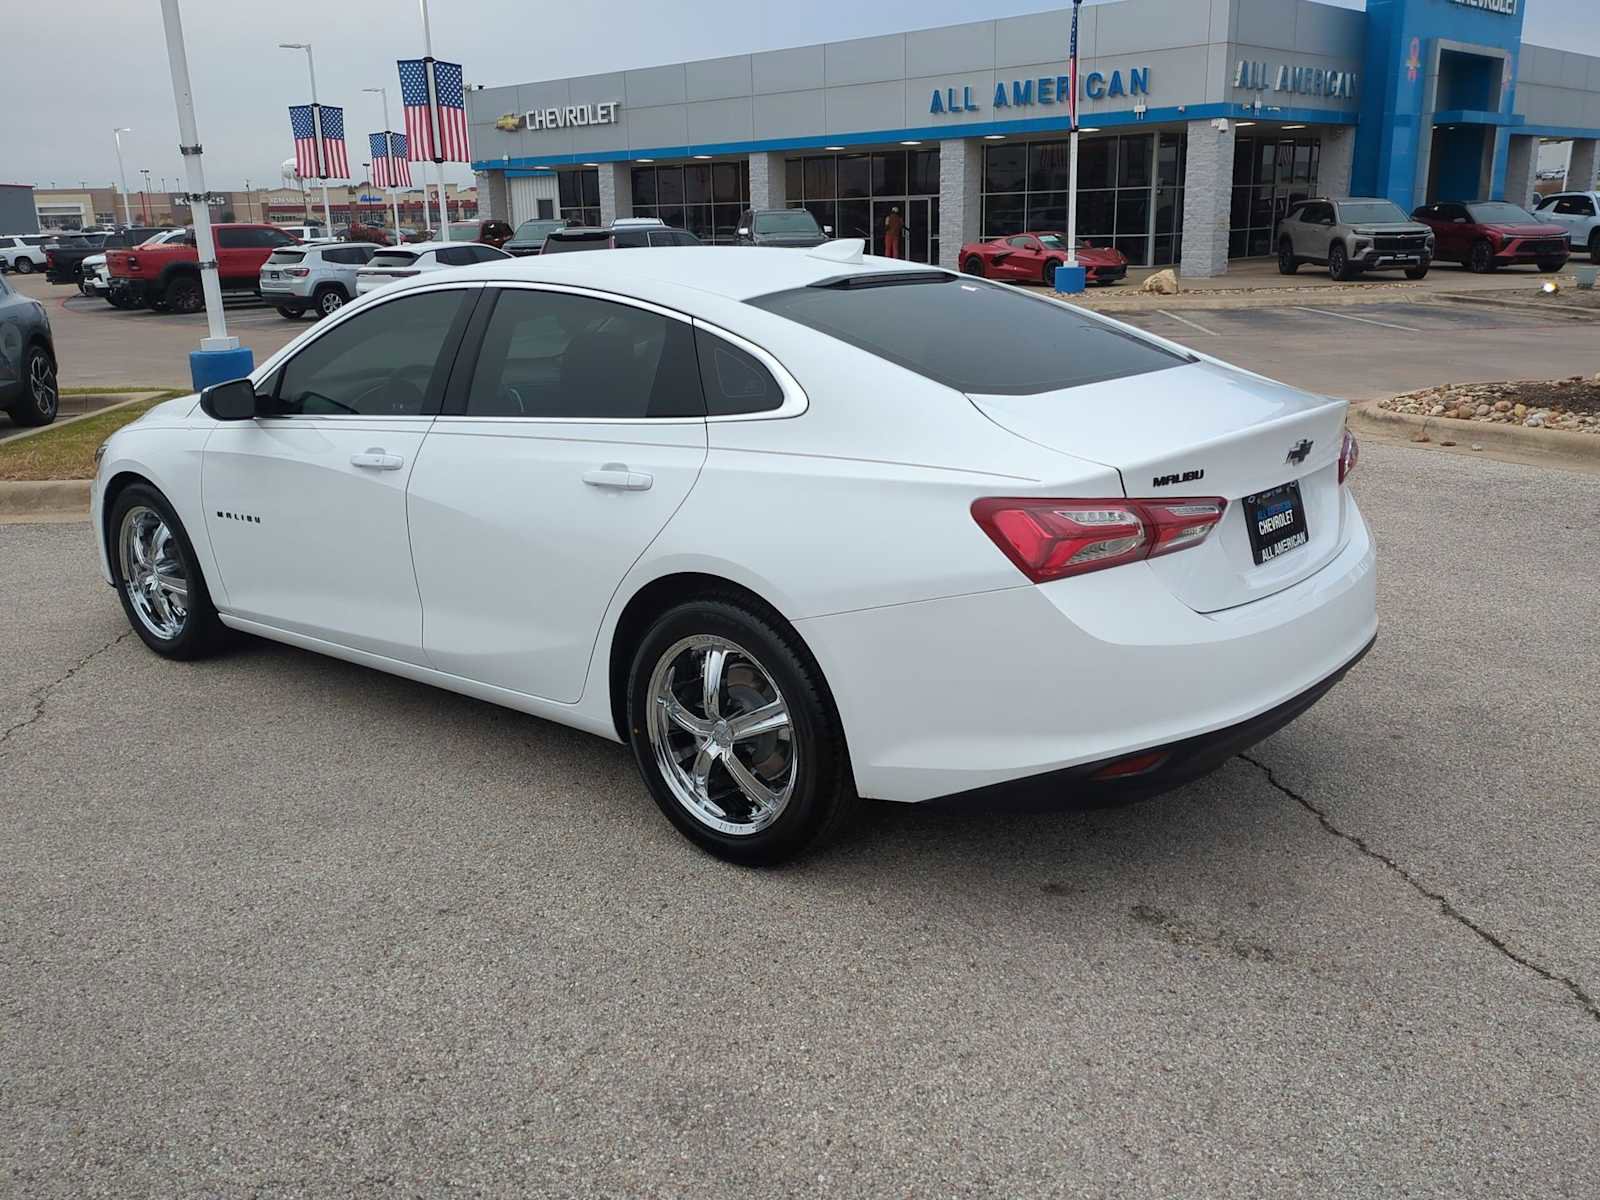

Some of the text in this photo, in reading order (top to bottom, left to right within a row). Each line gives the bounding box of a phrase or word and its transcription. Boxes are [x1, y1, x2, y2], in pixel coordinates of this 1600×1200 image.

[929, 67, 1150, 114] ALL AMERCAN
[1232, 60, 1360, 98] ALL AMERICAN
[525, 101, 619, 130] CHEVROLET
[174, 196, 225, 206] KL'S
[1152, 469, 1204, 488] MALIBU
[216, 511, 261, 524] MALIBU
[1258, 509, 1295, 536] CHEVROLET
[1261, 531, 1306, 562] ALL AMERICAN
